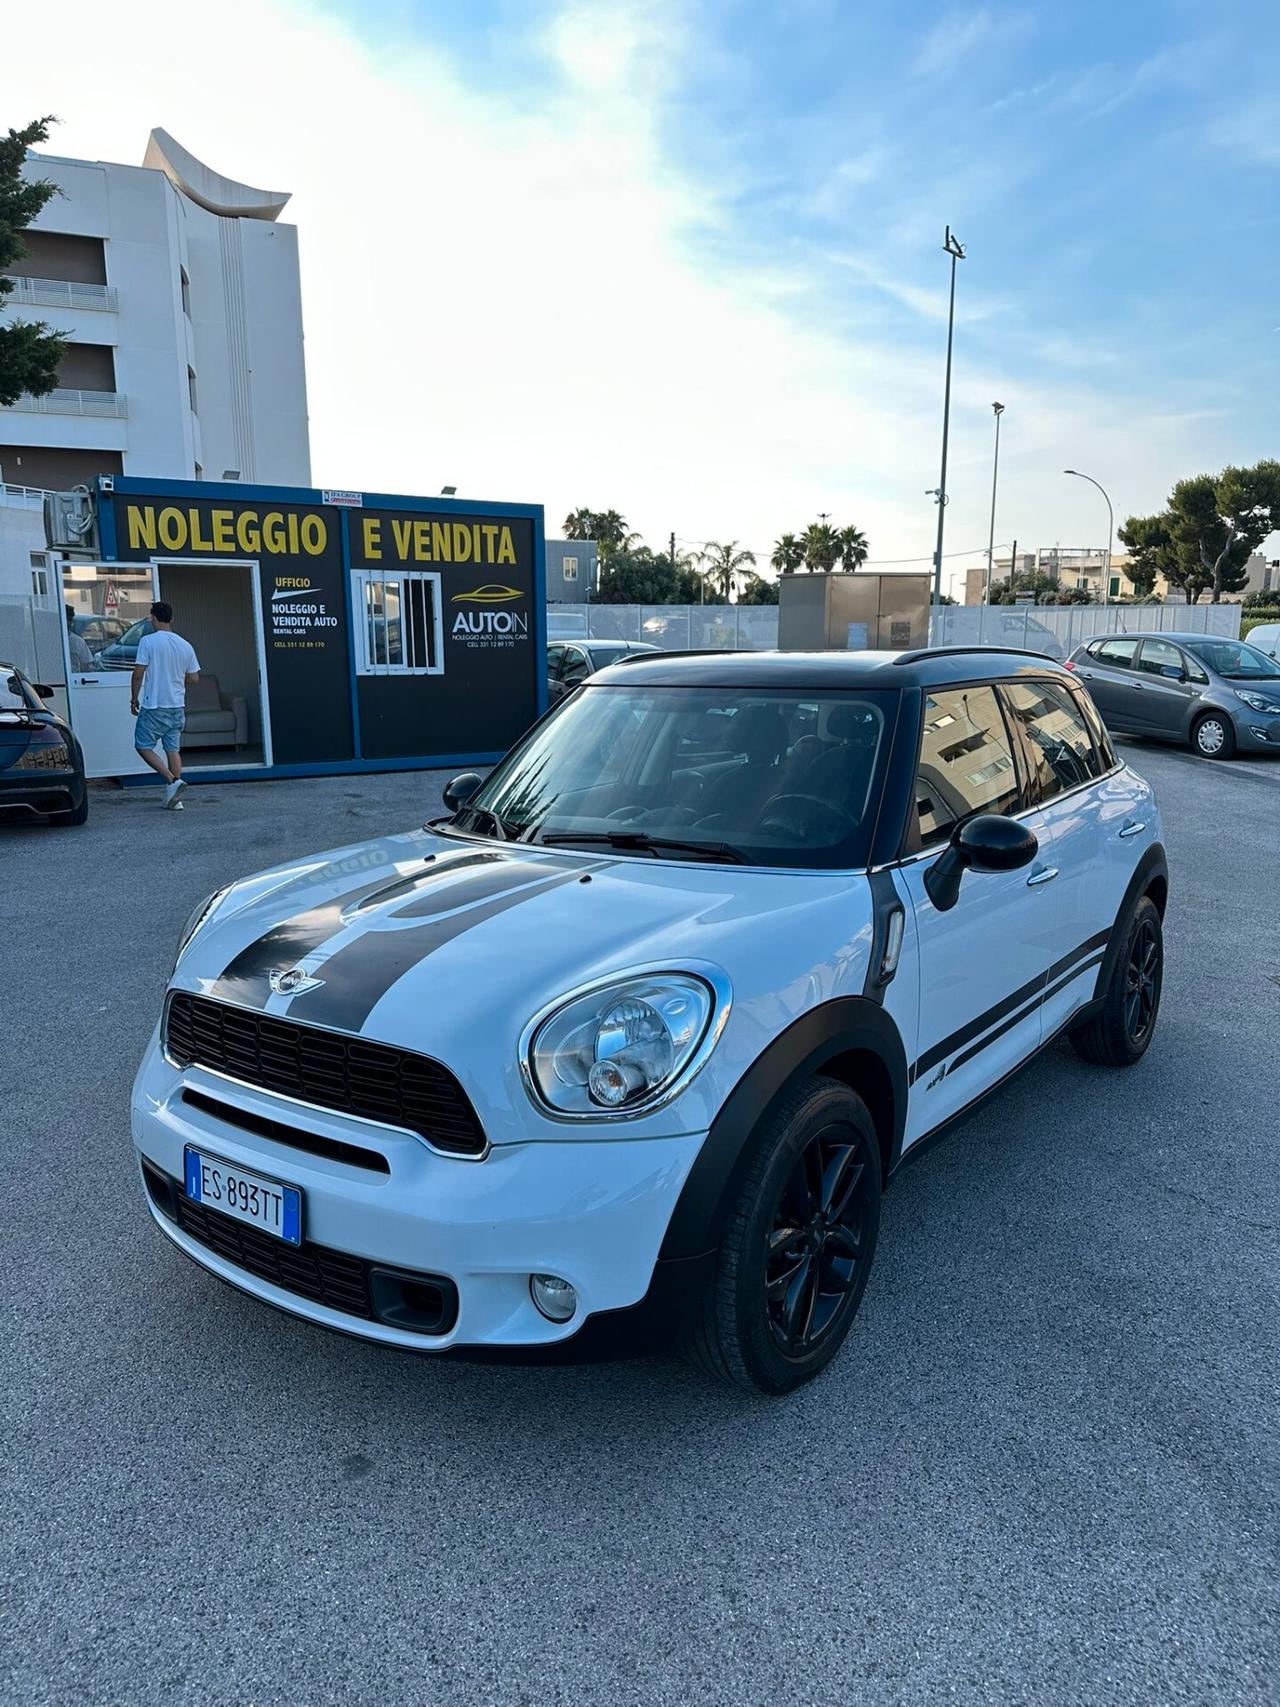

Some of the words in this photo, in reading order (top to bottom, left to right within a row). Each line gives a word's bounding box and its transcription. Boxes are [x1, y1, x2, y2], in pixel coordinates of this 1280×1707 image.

[127, 505, 327, 556] NOLEGGIO
[362, 518, 382, 559] E
[391, 519, 517, 564] VENDITA
[275, 577, 311, 588] UFFICIO
[272, 603, 317, 614] NOLEGGIO
[319, 604, 326, 614] E
[272, 616, 312, 626] VENDITA
[314, 616, 338, 627] AUTO
